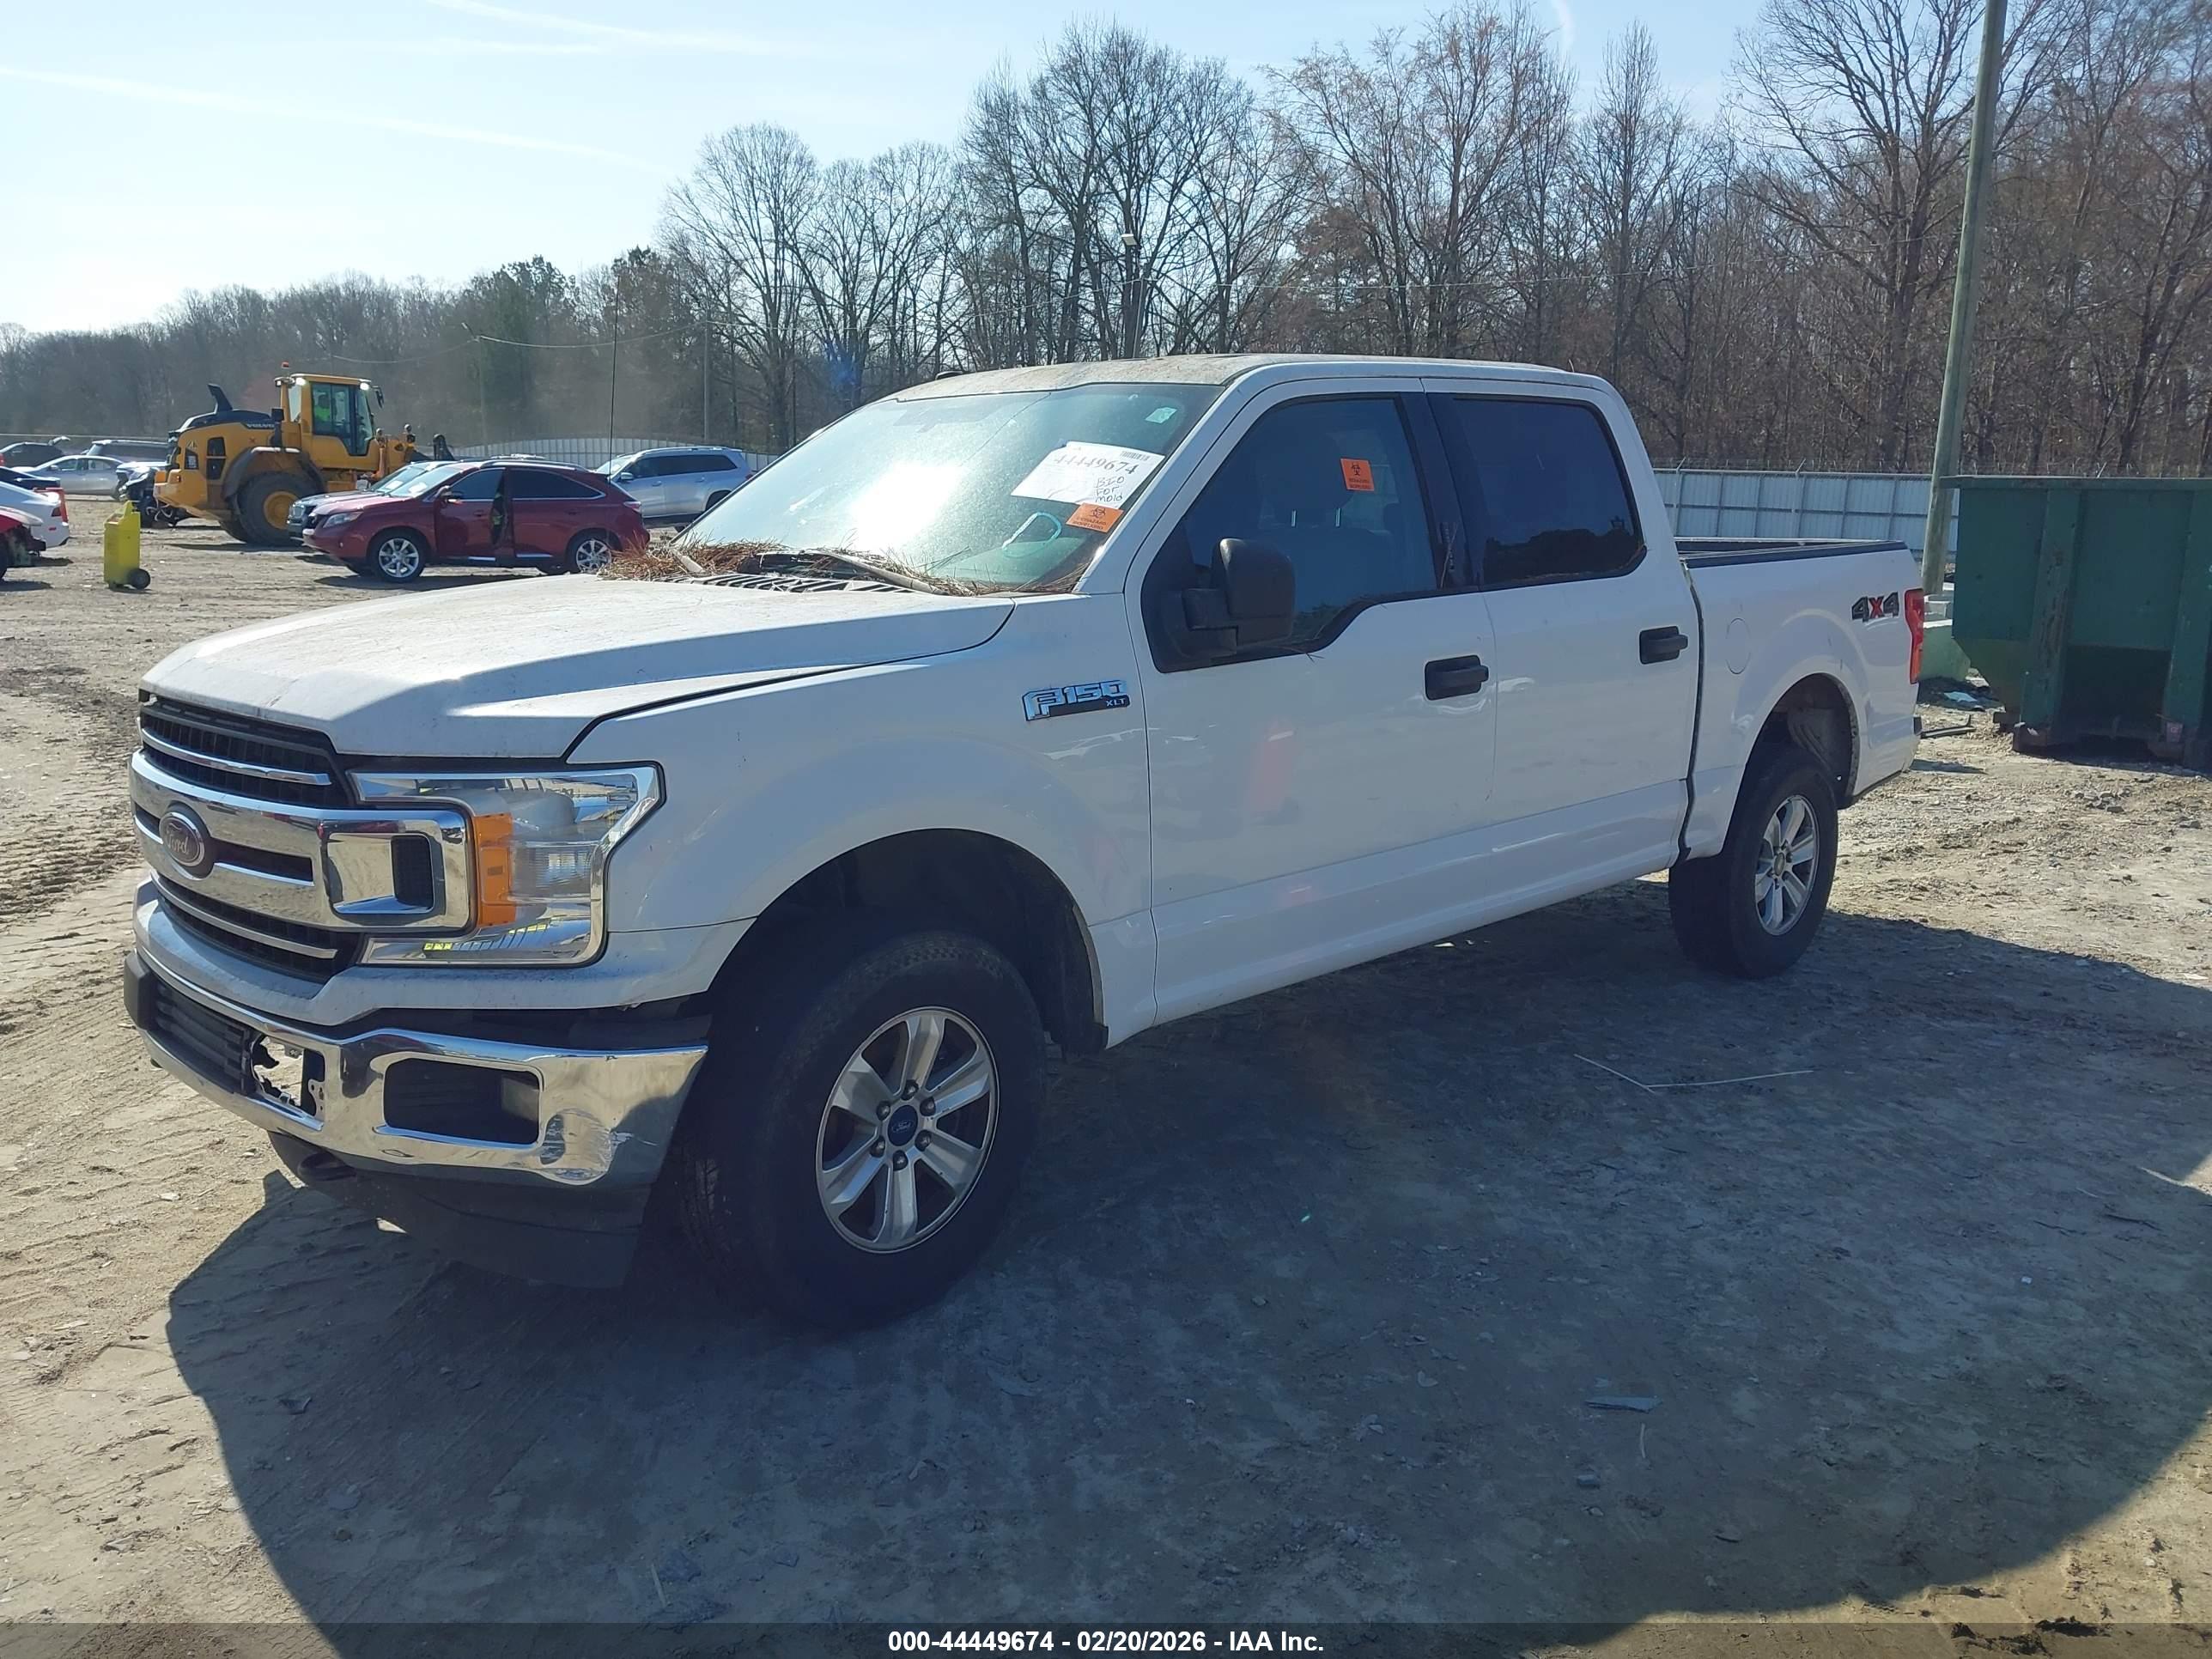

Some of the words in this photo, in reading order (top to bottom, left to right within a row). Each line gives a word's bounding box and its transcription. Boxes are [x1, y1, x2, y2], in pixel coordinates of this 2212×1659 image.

[1053, 454, 1139, 475] 44449674
[1095, 476, 1125, 488] BIO
[1105, 698, 1127, 708] XLT
[166, 822, 190, 855] Ford
